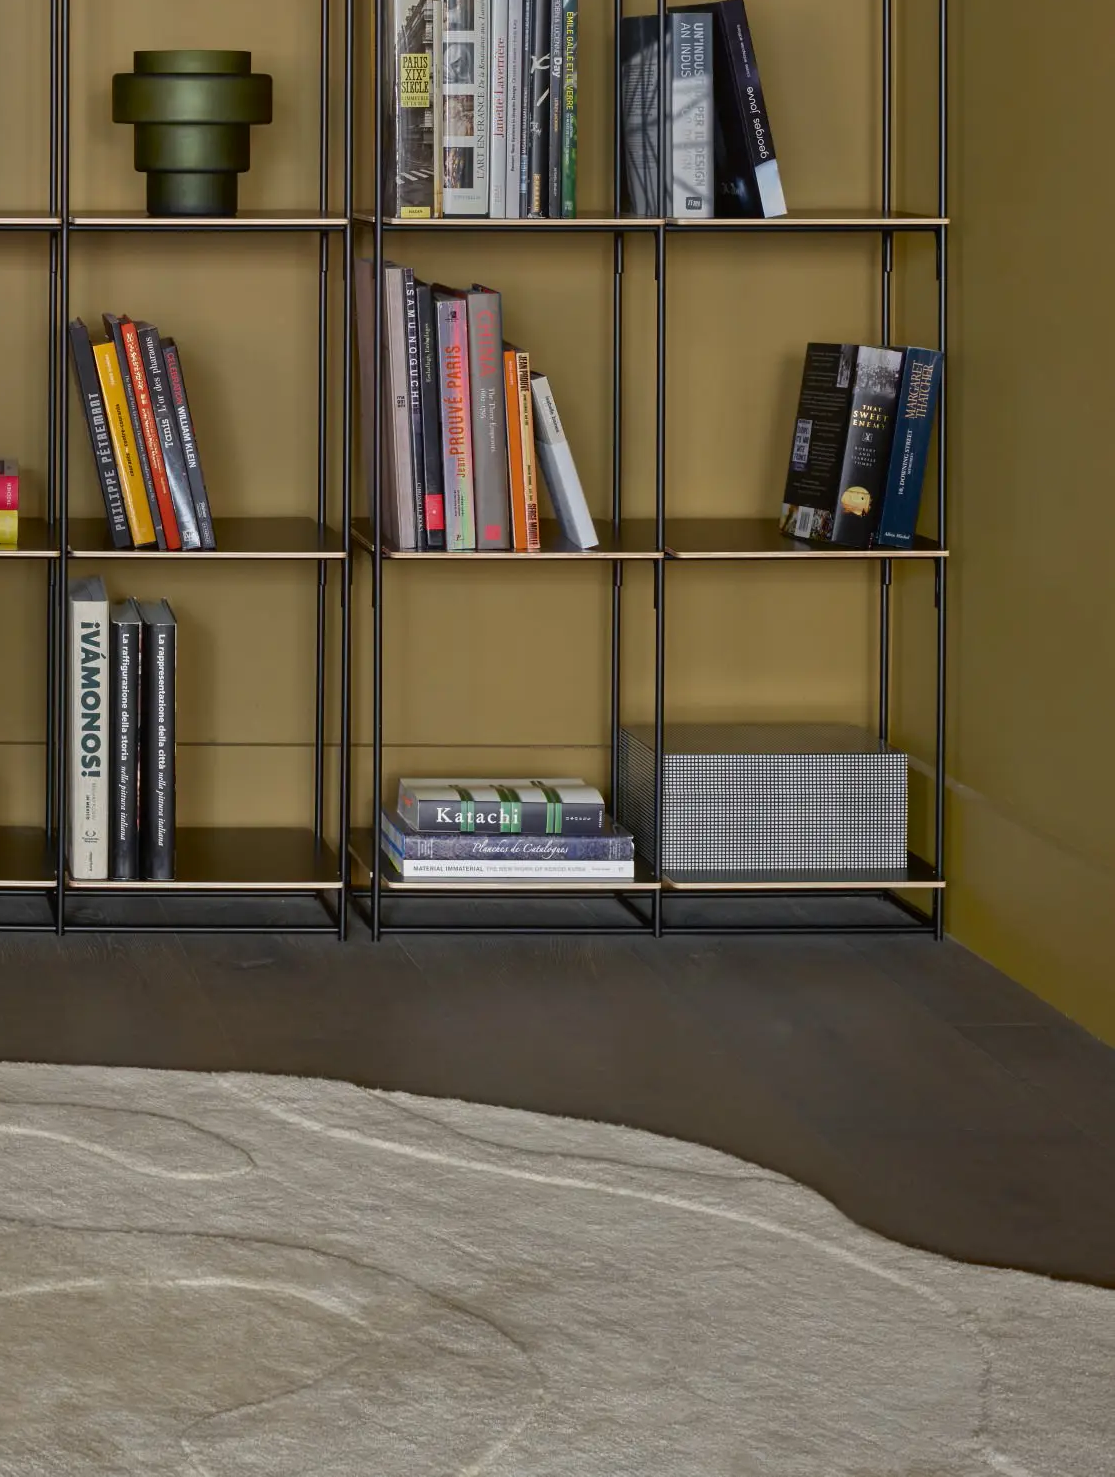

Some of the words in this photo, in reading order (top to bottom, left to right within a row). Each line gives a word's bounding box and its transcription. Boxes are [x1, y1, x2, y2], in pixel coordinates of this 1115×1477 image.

[680, 23, 691, 37] AN
[402, 56, 428, 69] PARIS
[551, 57, 562, 78] Day
[566, 63, 574, 73] ET
[566, 75, 574, 84] LE
[566, 86, 574, 110] VERRE
[746, 86, 761, 114] jouve
[476, 92, 485, 132] FRANCE
[493, 99, 505, 138] Janette
[695, 106, 705, 126] PER
[477, 134, 485, 148] EN
[752, 118, 770, 159] georges
[476, 152, 485, 179] L'ART
[695, 146, 705, 187] DESIGN
[406, 282, 417, 329] ISAMU
[145, 336, 160, 374] pharaons
[476, 310, 497, 377] CHINA
[408, 336, 420, 407] NOGUCHI
[445, 346, 460, 389] PARIS
[153, 377, 163, 392] des
[905, 362, 924, 419] MARGARET
[915, 364, 934, 418] THATCHER
[157, 395, 167, 412] L'or
[167, 352, 183, 405] CELEBRATION
[177, 406, 190, 441] WILLIAM
[185, 444, 197, 468] KLEIN
[853, 411, 889, 422] SWEET
[862, 404, 883, 412] THAT
[160, 418, 173, 448] Tanis
[443, 396, 465, 456] PROUVÉ
[853, 420, 886, 430] ENEMY
[518, 355, 529, 370] JEAN
[528, 503, 538, 522] SERGE
[900, 455, 910, 487] DOWNING
[905, 429, 913, 454] STREET
[103, 469, 126, 530] PHILIPPE
[121, 634, 129, 644] La
[158, 634, 166, 645] La
[119, 646, 129, 709] raffigurazione
[156, 646, 166, 723] rappresentazione
[81, 621, 106, 778] ¡VÁMONOS!
[120, 711, 130, 733] della
[120, 735, 129, 761] storia
[158, 725, 166, 747] della
[158, 749, 167, 770] città
[120, 766, 128, 783] nella
[157, 772, 166, 790] nella
[118, 784, 128, 810] pittura
[156, 791, 166, 816] pittura
[119, 812, 128, 840] italiana
[436, 807, 519, 824] Katachi
[157, 818, 166, 846] italiana
[472, 839, 508, 853] Planches
[509, 842, 520, 853] de
[523, 841, 568, 859] Catalogues
